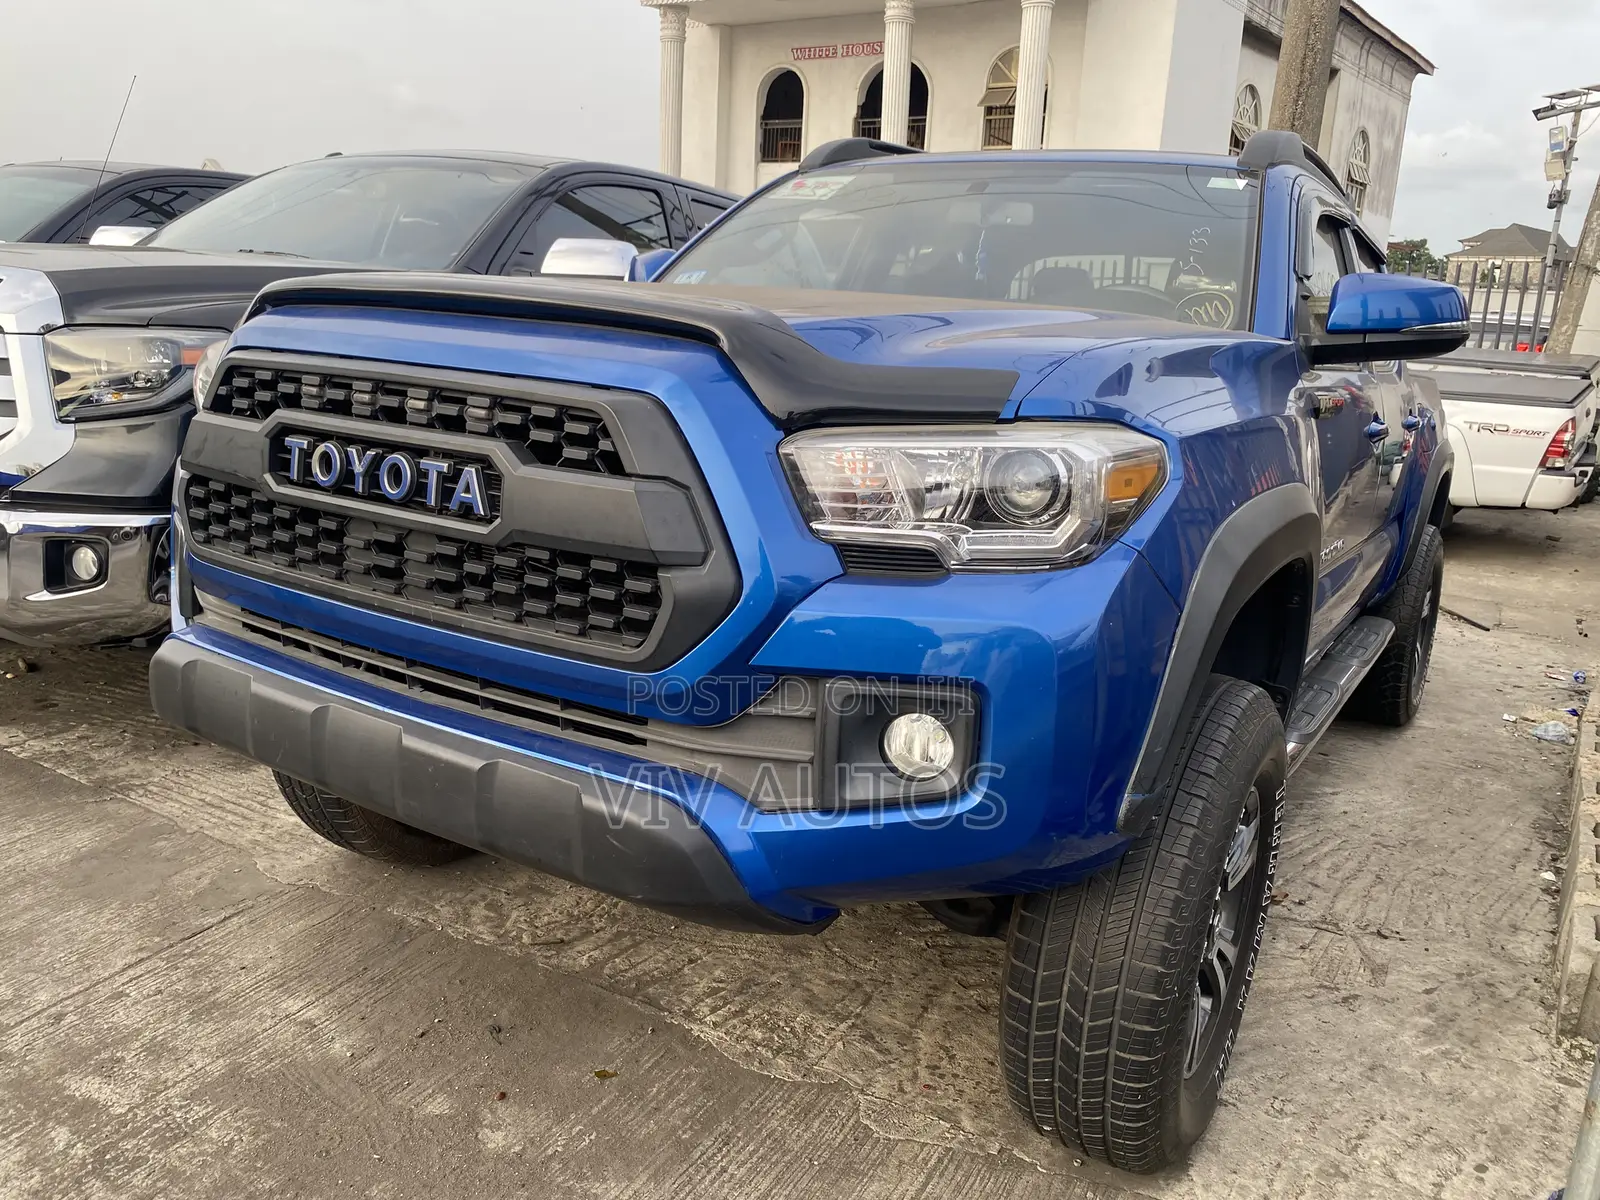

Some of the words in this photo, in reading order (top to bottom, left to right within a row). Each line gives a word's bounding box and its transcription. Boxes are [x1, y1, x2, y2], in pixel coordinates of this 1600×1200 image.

[791, 45, 838, 61] WHITE
[1463, 420, 1510, 434] TRD
[1510, 428, 1550, 437] SPORT
[284, 434, 492, 519] TOYOTA
